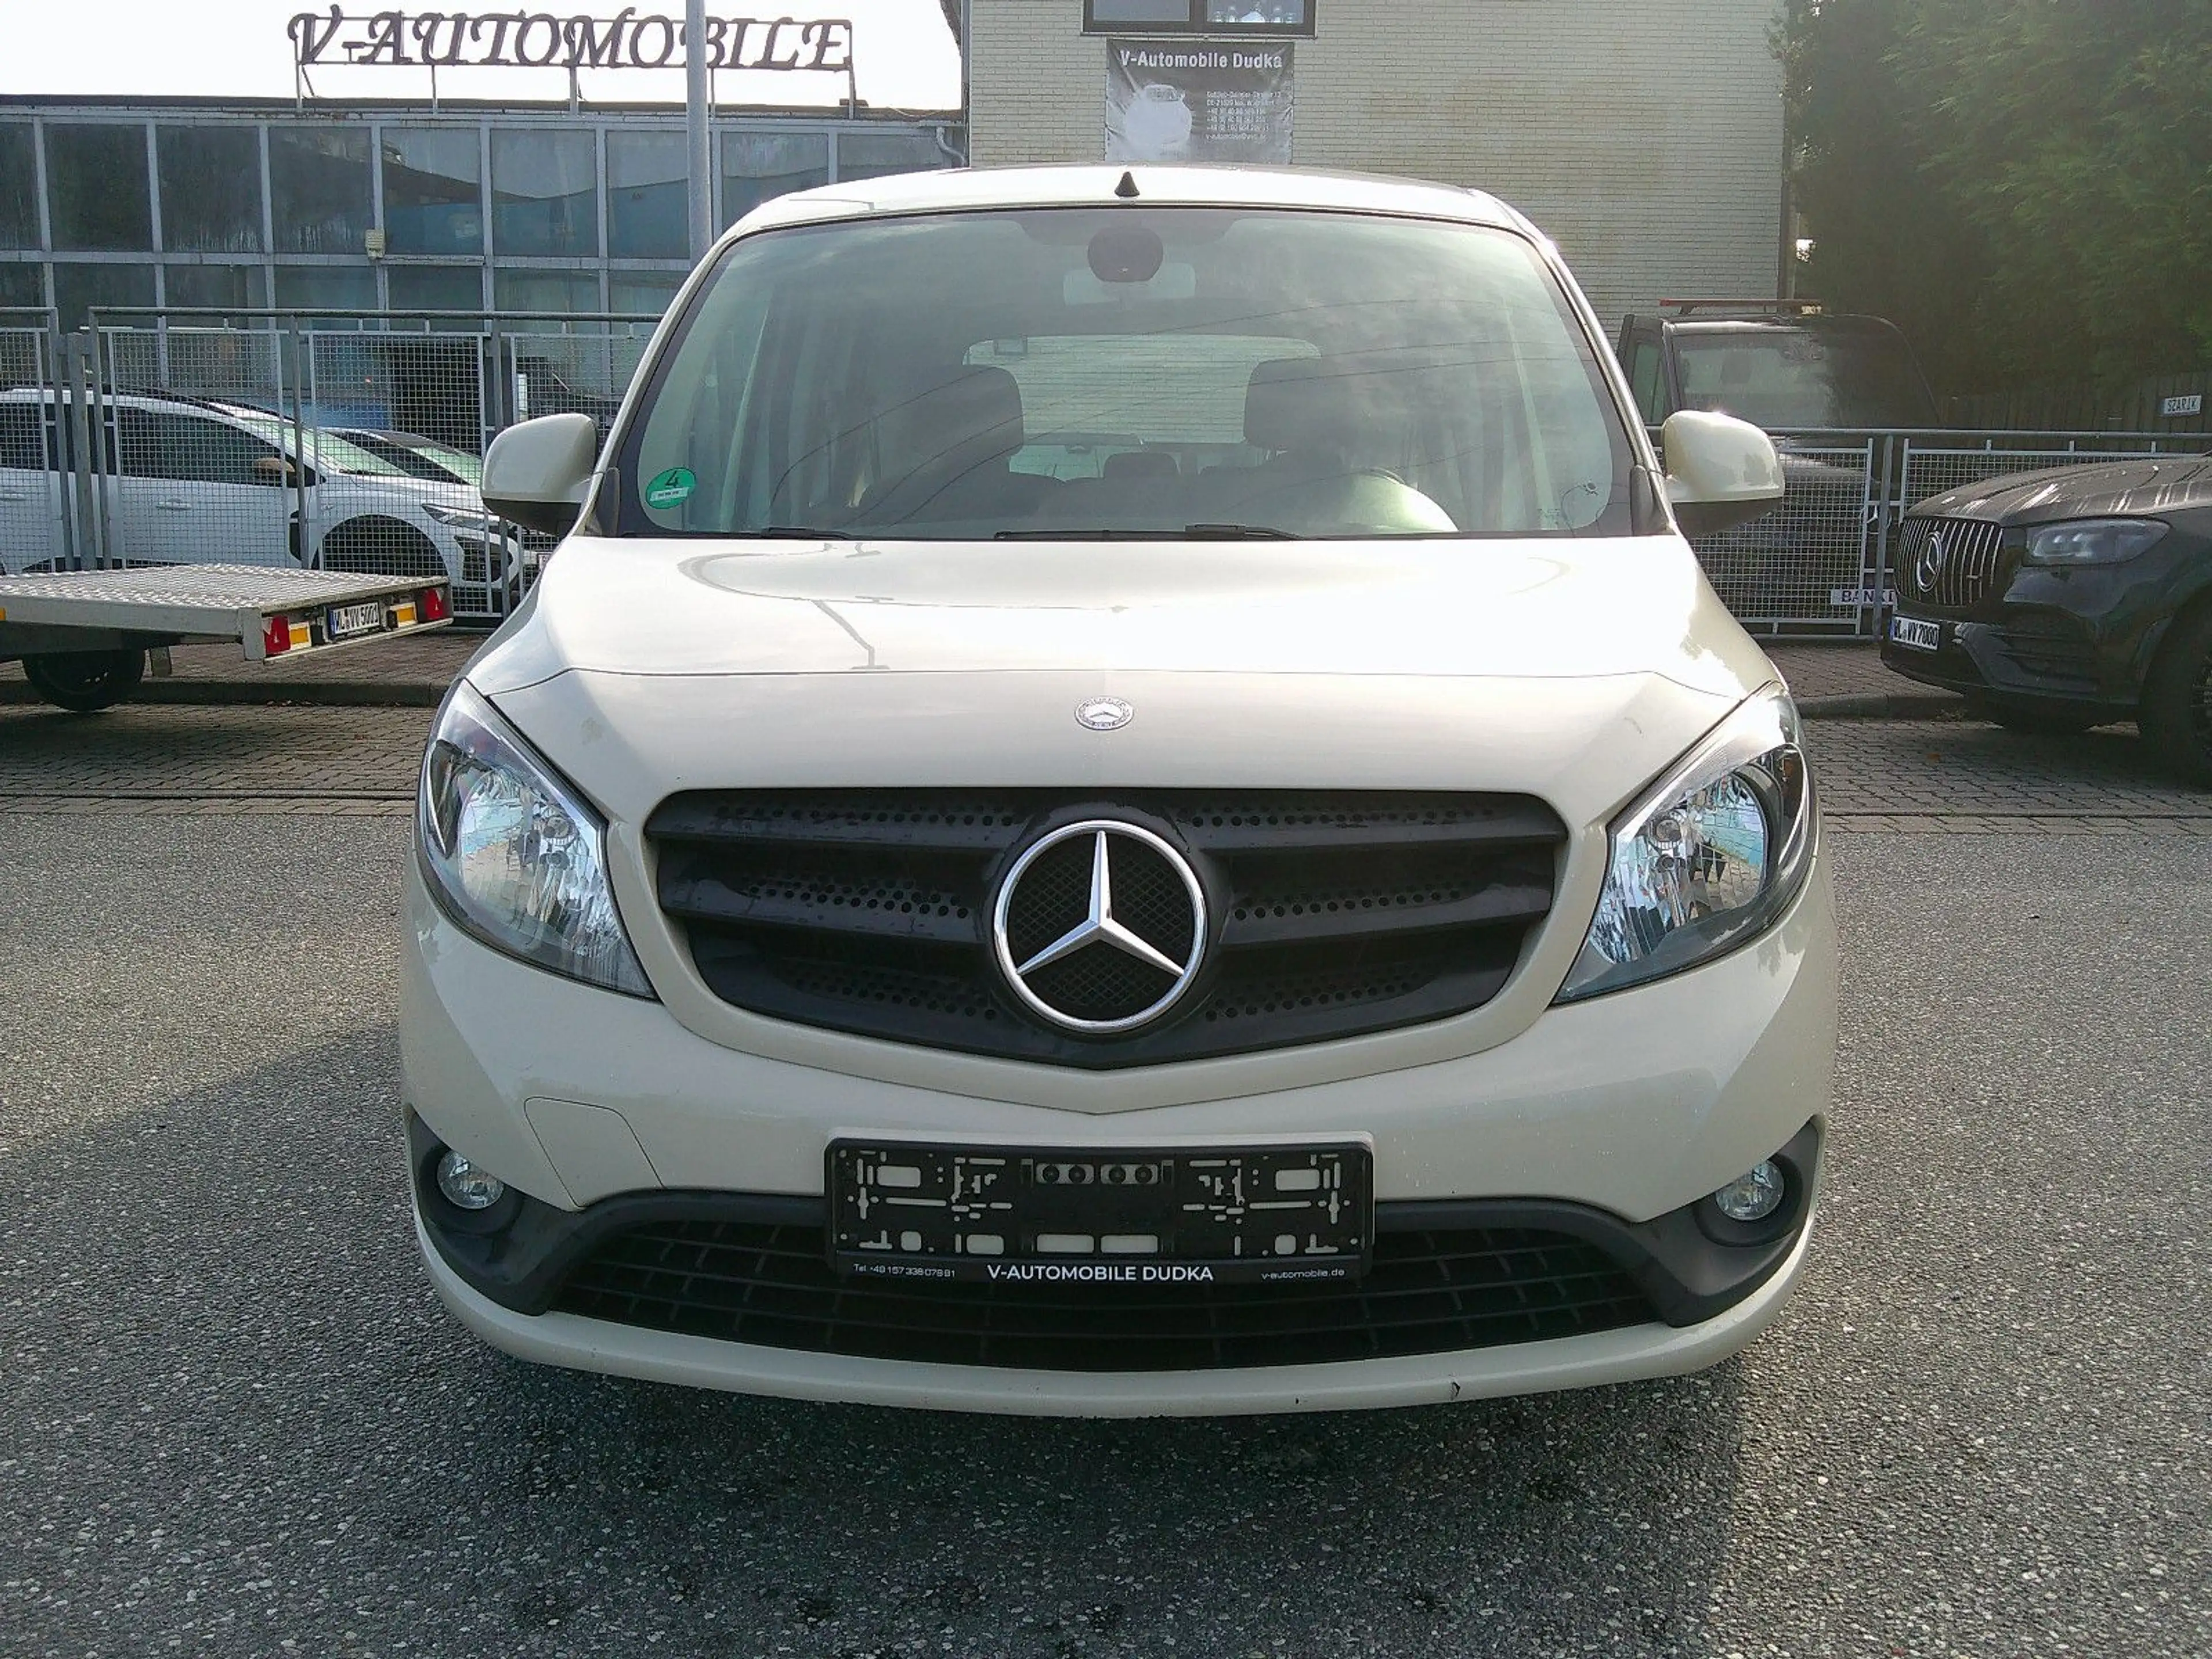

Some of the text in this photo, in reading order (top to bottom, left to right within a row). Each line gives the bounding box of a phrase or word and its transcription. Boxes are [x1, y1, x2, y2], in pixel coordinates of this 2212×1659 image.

[287, 5, 852, 70] V-AUTOMOBILE
[1119, 50, 1283, 69] V-Automobile Dudka
[664, 469, 679, 487] 4
[987, 1264, 1214, 1282] V-AUTOMOBILE DUDKA
[1260, 1268, 1345, 1280] v-automobile.de
